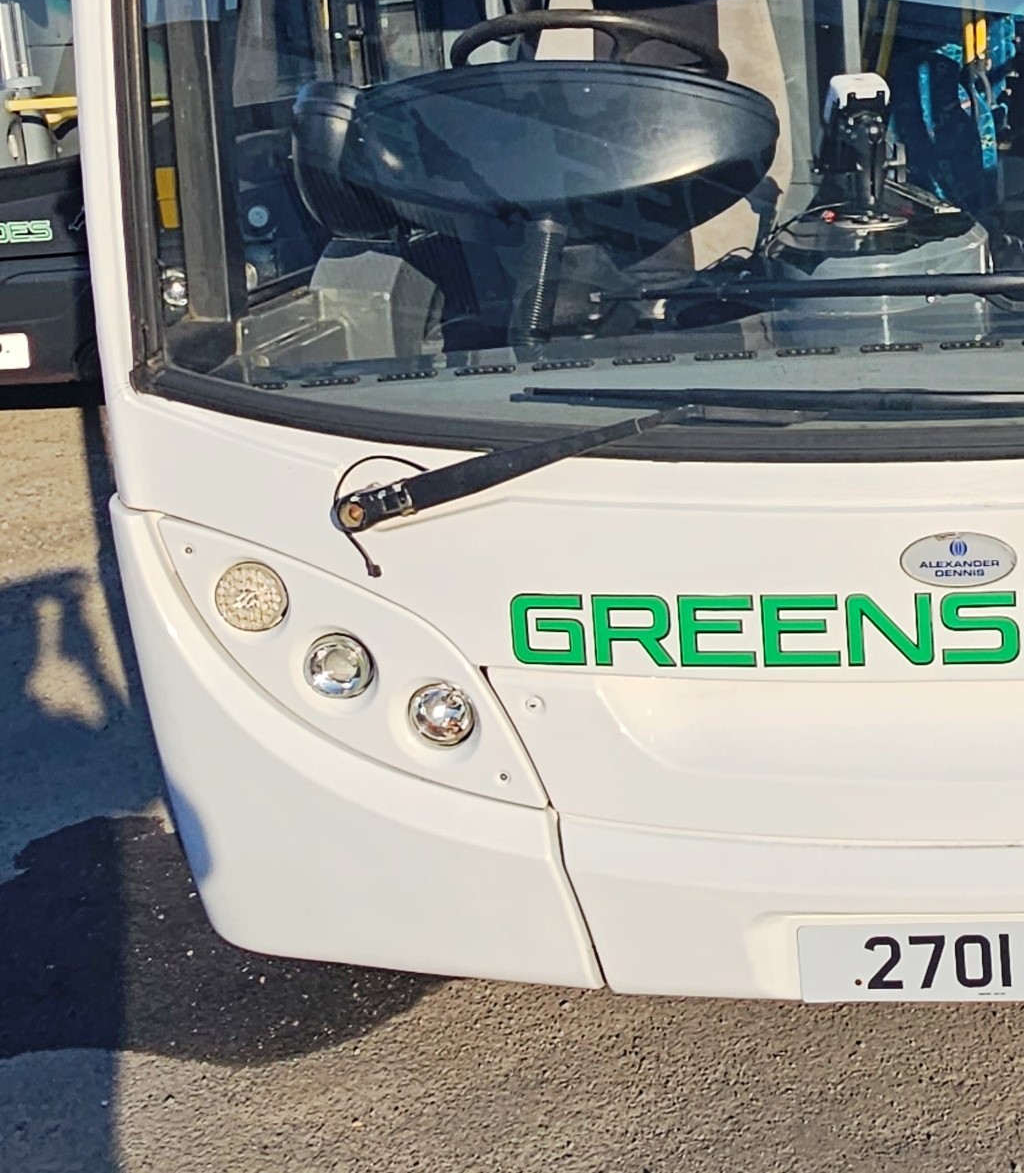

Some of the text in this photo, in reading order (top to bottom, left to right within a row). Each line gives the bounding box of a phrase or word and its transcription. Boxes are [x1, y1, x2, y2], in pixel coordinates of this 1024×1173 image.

[919, 560, 1000, 568] ALEXANDER
[934, 569, 985, 577] DENNIS
[863, 932, 1012, 990] 2701
